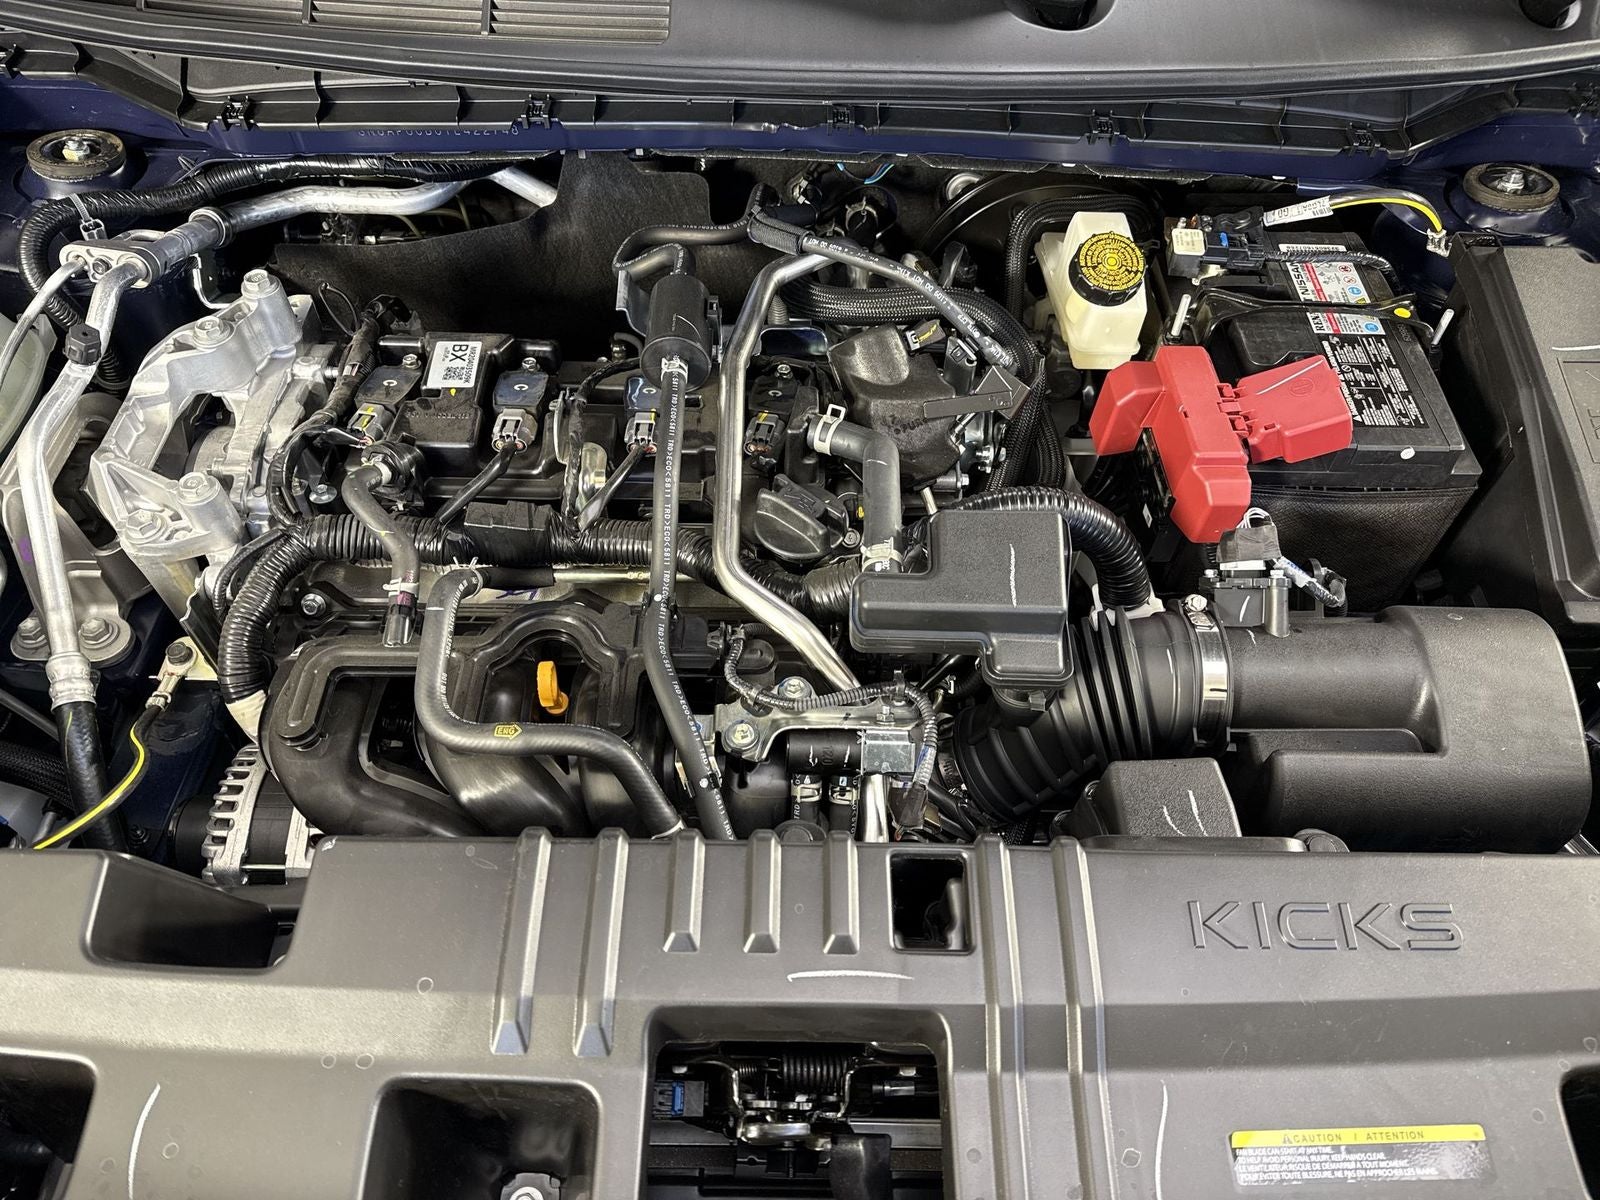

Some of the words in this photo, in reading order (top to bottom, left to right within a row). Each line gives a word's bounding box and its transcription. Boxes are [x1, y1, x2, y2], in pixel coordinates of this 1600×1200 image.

[449, 343, 469, 363] BX
[497, 727, 515, 735] ENG
[1187, 900, 1464, 951] KICKS
[1293, 1133, 1342, 1143] CAUTION
[1366, 1130, 1425, 1141] ATTENTION
